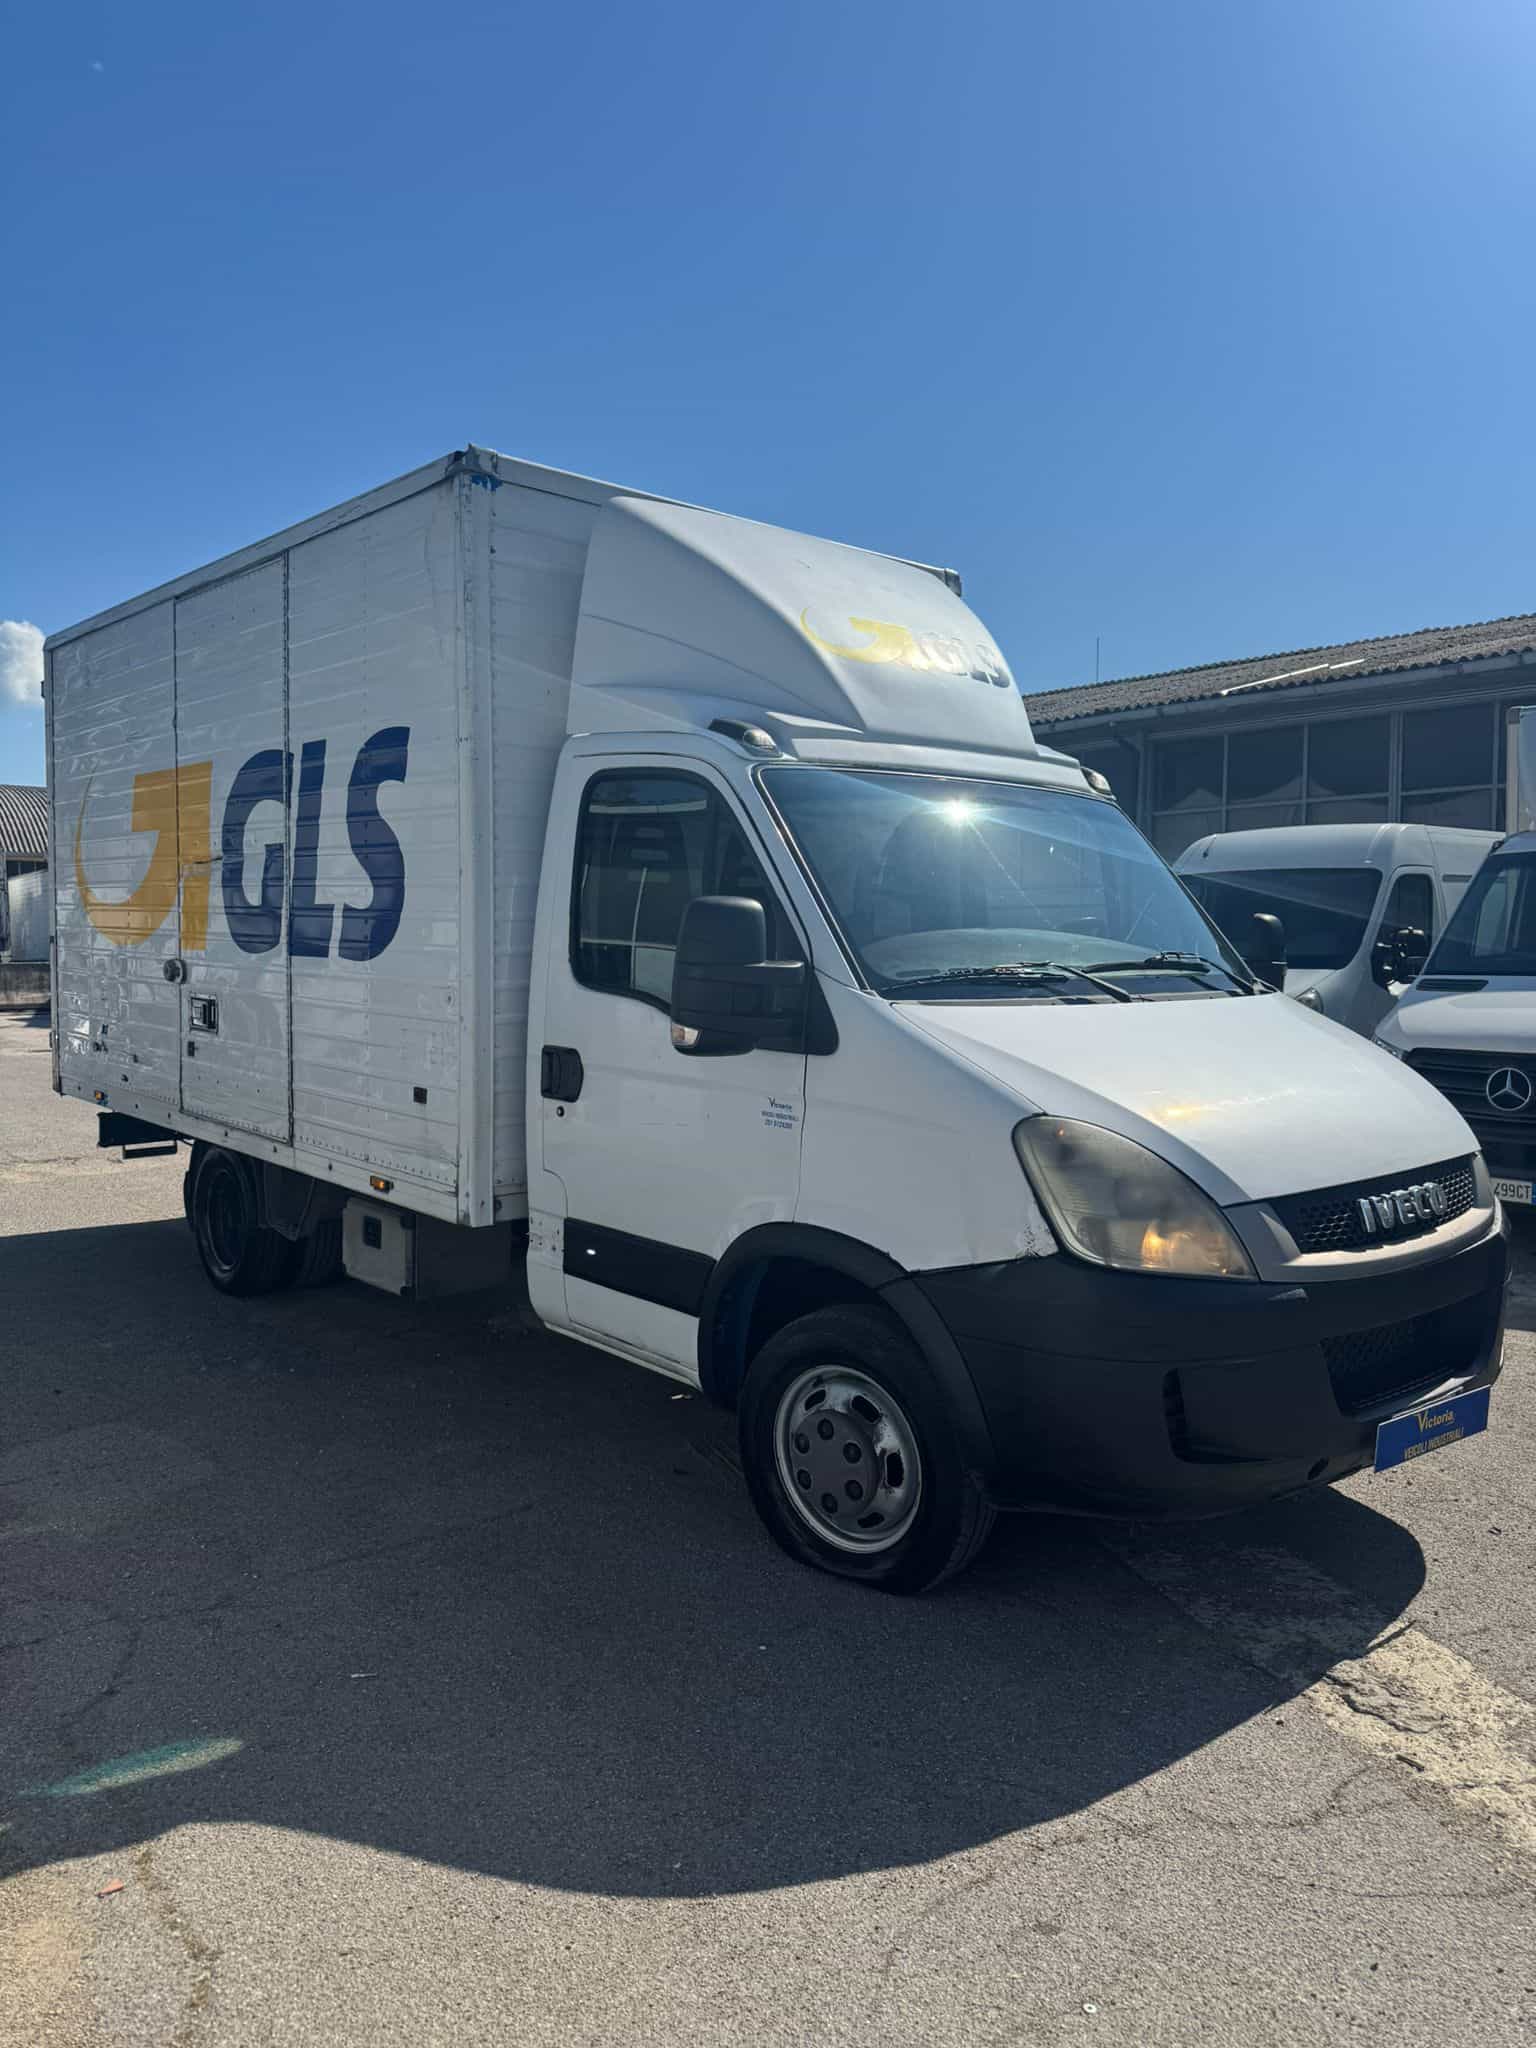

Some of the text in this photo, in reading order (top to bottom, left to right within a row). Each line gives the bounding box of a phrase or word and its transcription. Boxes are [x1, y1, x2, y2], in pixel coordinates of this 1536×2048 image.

[222, 726, 411, 962] GLS
[1358, 1182, 1448, 1233] IVECO
[1415, 1410, 1455, 1432] Victoria
